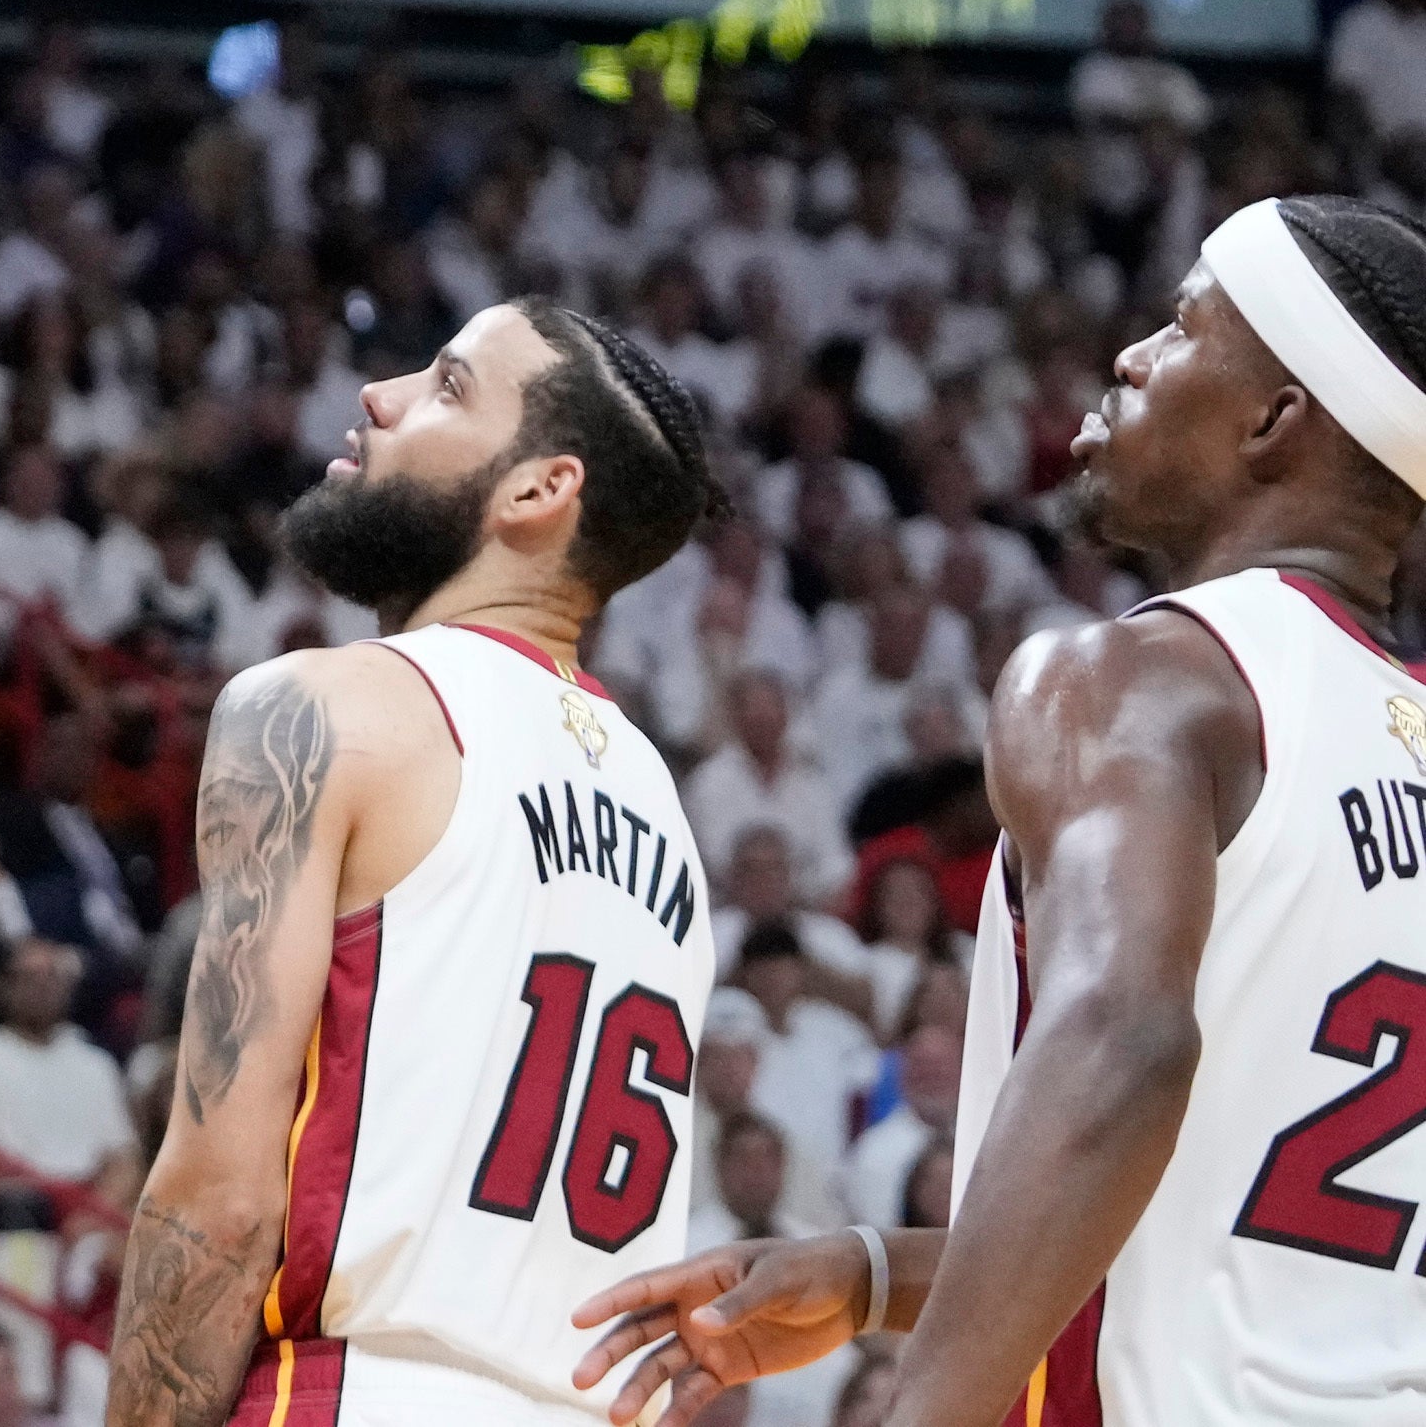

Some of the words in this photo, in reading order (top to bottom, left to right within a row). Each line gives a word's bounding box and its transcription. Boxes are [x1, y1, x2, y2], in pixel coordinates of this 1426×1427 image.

[515, 779, 695, 948] MARTIN
[467, 952, 694, 1254] 16
[1231, 959, 1426, 1277] 2
